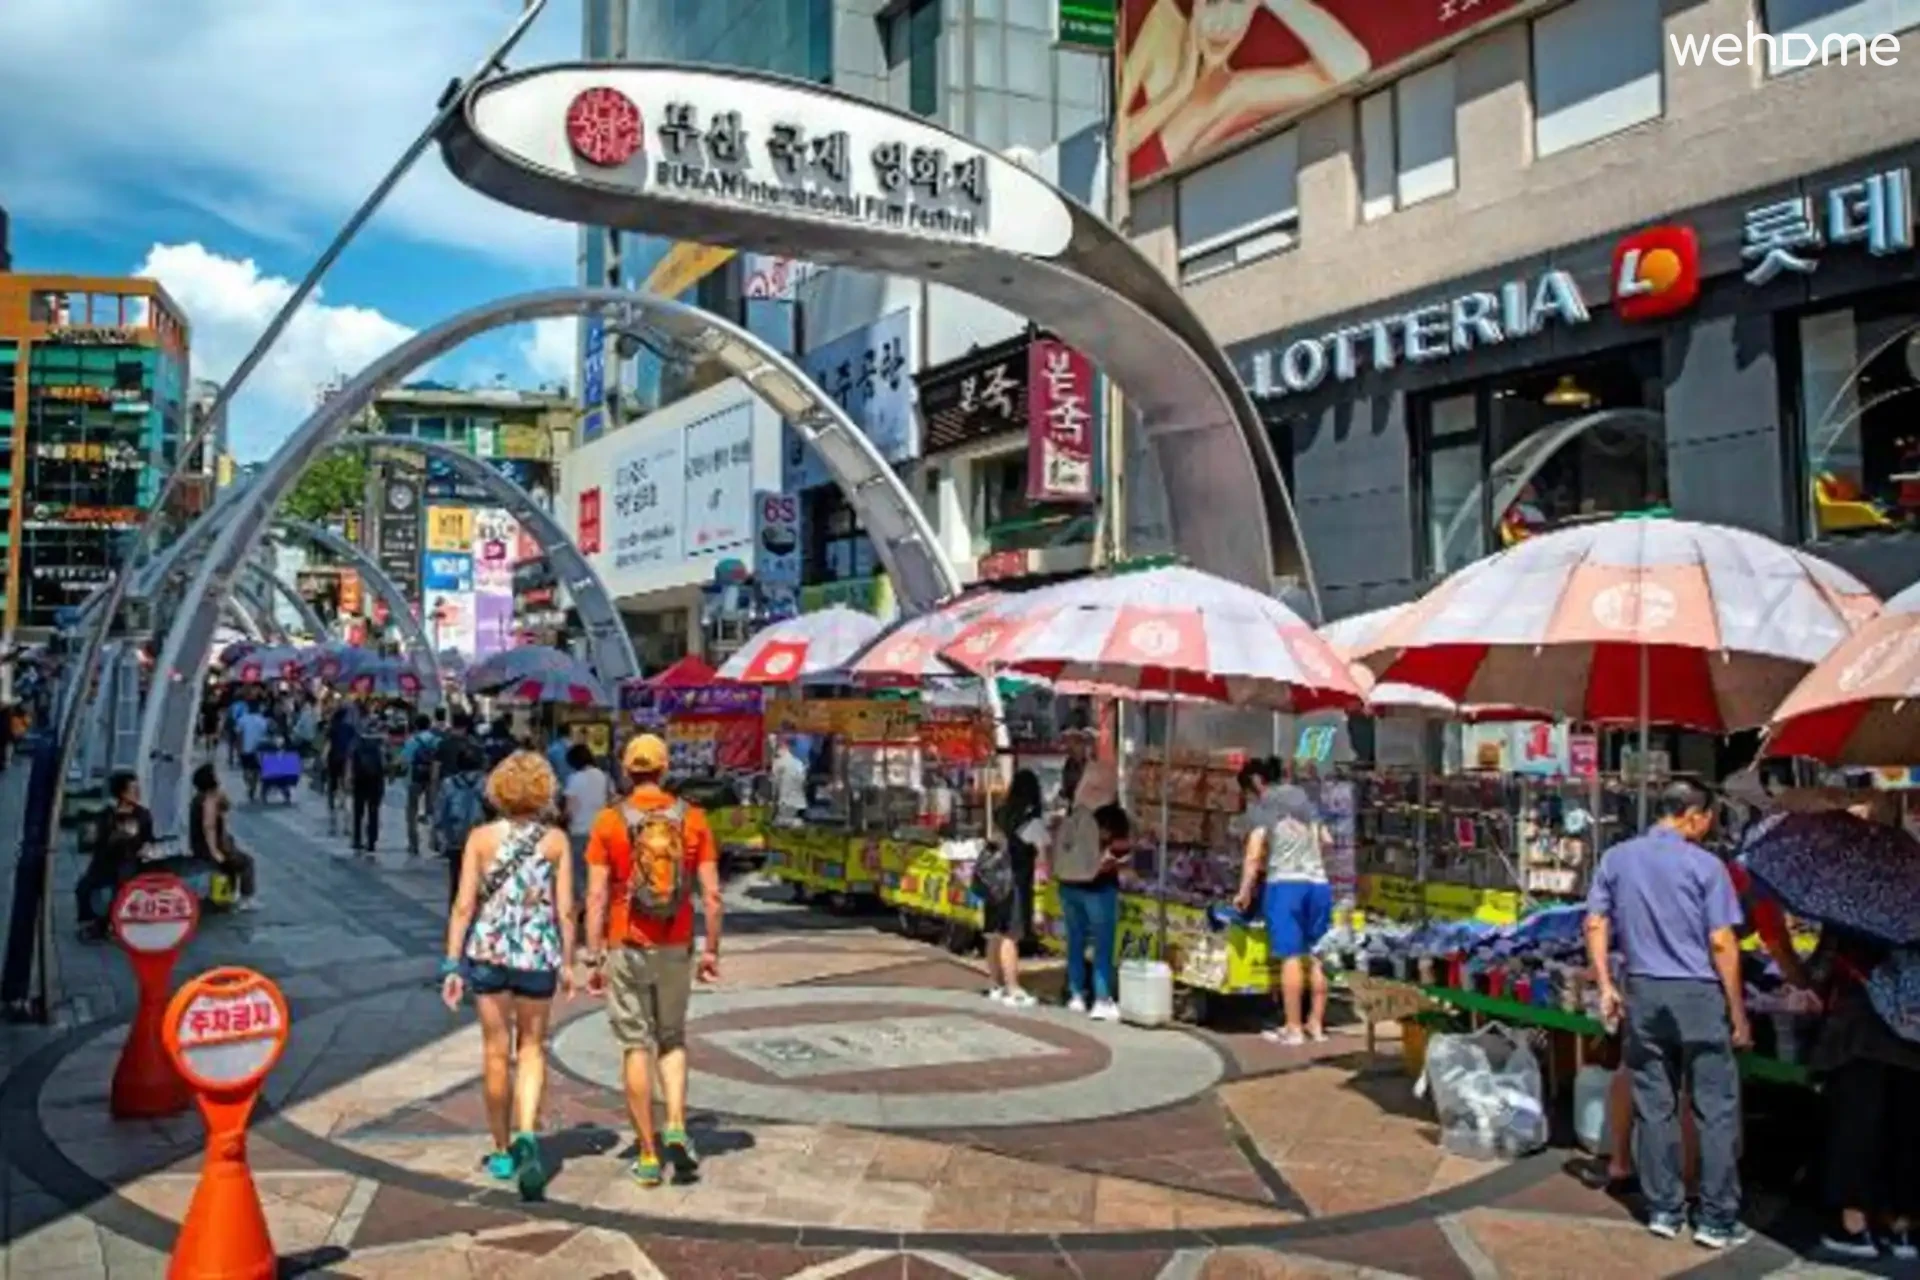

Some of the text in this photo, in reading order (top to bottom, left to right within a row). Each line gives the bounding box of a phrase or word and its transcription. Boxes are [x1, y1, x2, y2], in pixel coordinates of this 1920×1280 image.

[657, 161, 979, 235] BUSAN International Film Festival
[658, 102, 752, 168] 부산
[766, 122, 850, 183] 국제
[871, 141, 986, 204] 영화제
[1740, 168, 1915, 287] 롯데
[1248, 270, 1591, 399] LOTTERIA
